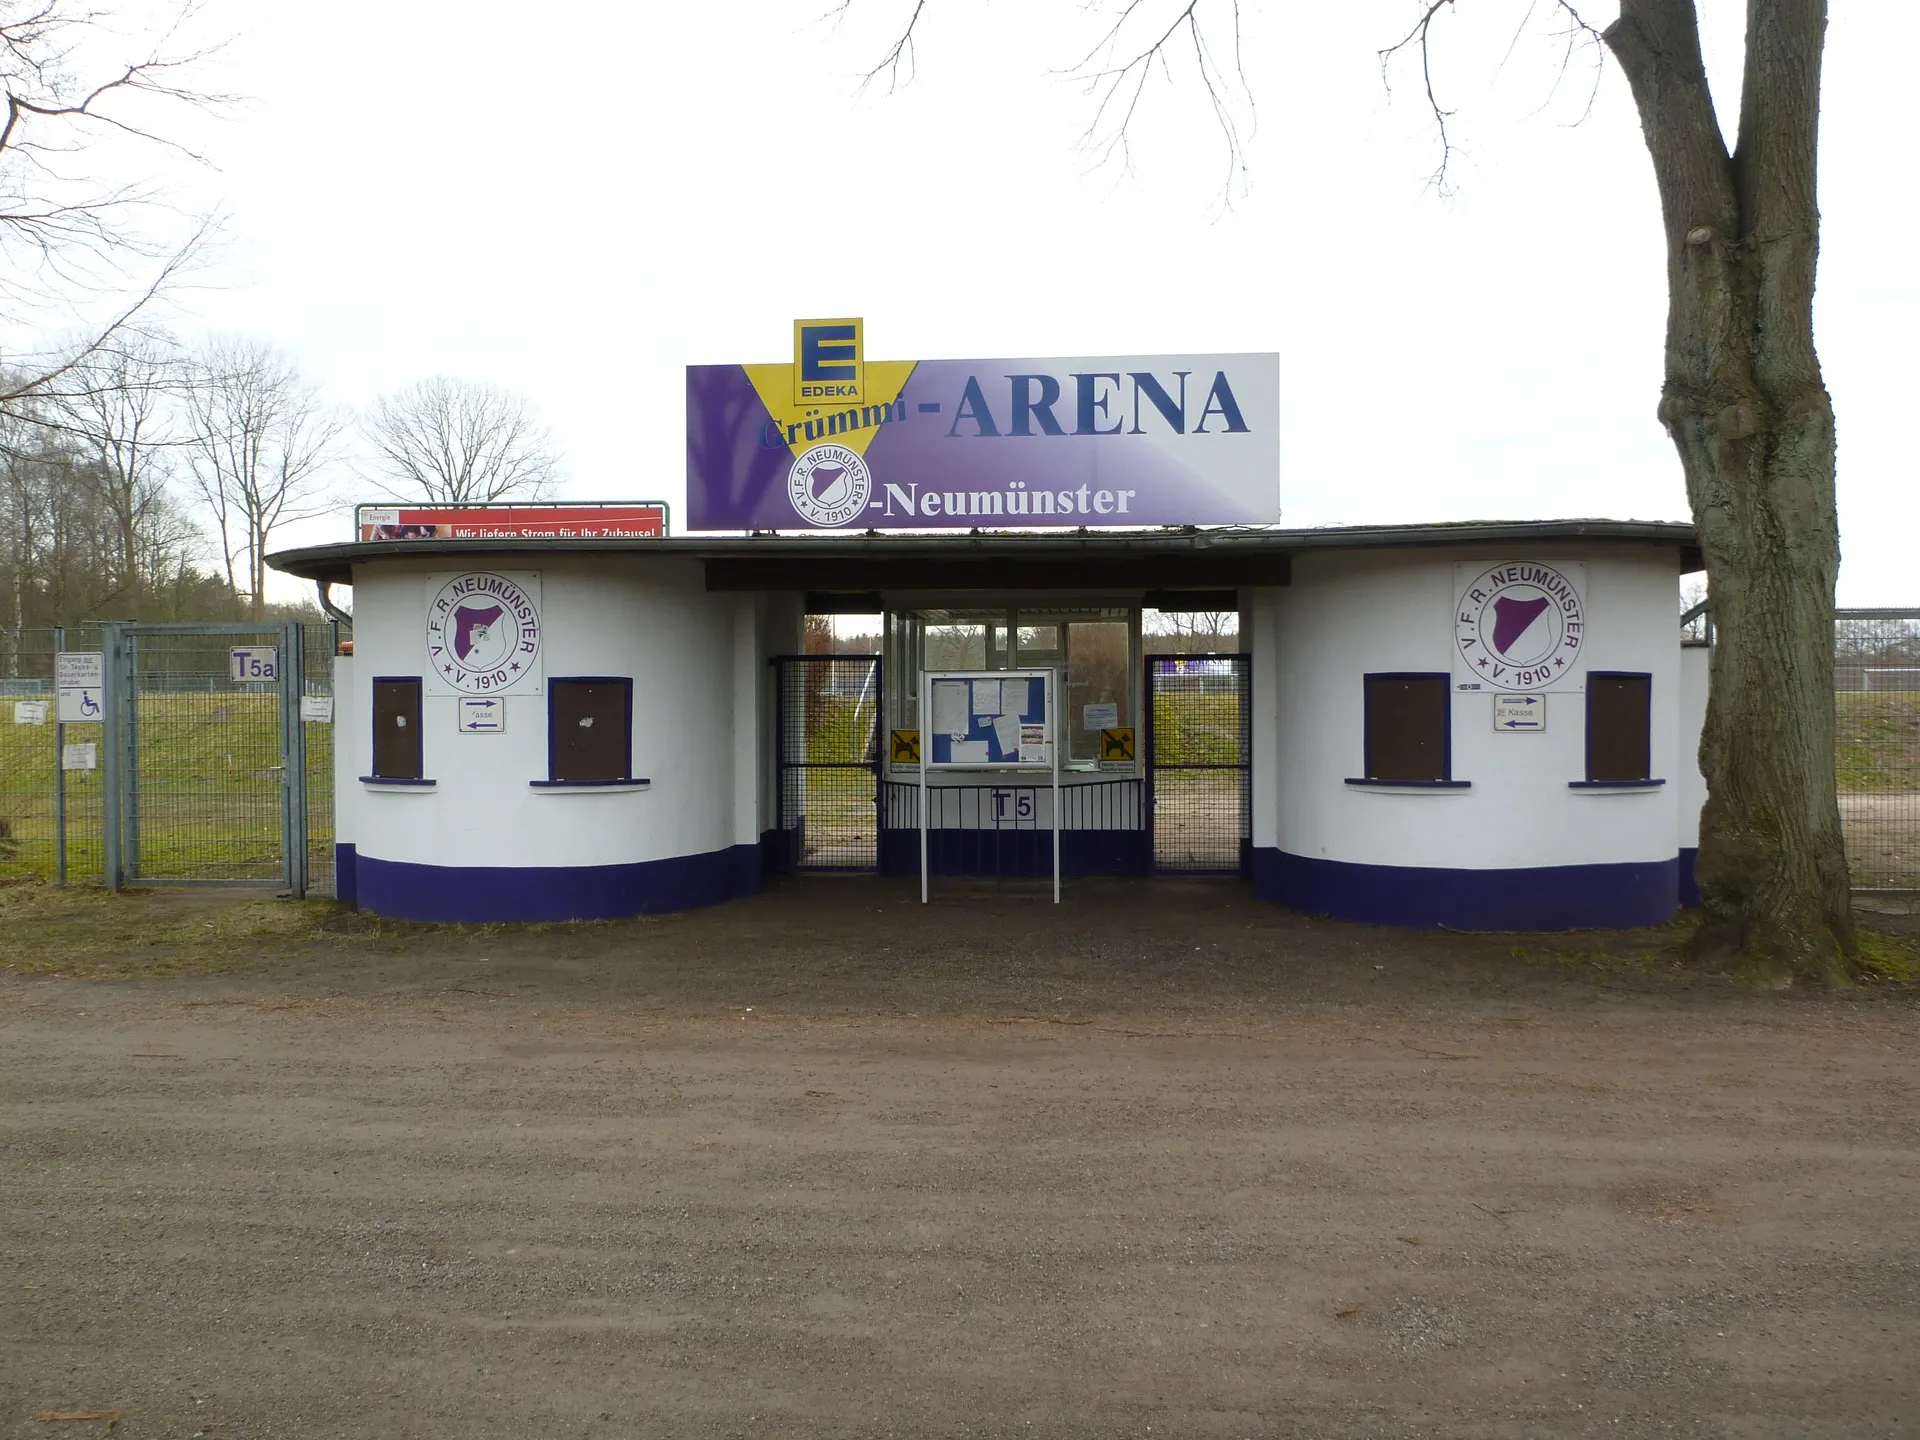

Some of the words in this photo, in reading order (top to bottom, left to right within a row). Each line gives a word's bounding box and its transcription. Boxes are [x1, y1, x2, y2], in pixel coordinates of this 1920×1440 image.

[802, 325, 856, 381] E
[801, 386, 858, 397] EDEKA
[758, 391, 906, 450] Grümmi
[807, 450, 865, 500] NEUMÜNSTER
[869, 481, 1136, 517] -Neumünster
[369, 514, 391, 522] Energie
[824, 506, 852, 521] 1910
[456, 529, 476, 537] Wir
[521, 528, 555, 537] Strom
[559, 528, 576, 537] für
[580, 528, 597, 537] Ihr
[452, 577, 537, 654] NEUMÜNSTER
[1491, 566, 1581, 649] NEUMÜNSTER
[59, 656, 82, 664] Eingang
[232, 652, 274, 677] T5a
[474, 669, 508, 690] 1910
[1515, 664, 1551, 685] 1910
[1508, 708, 1533, 716] Kasse
